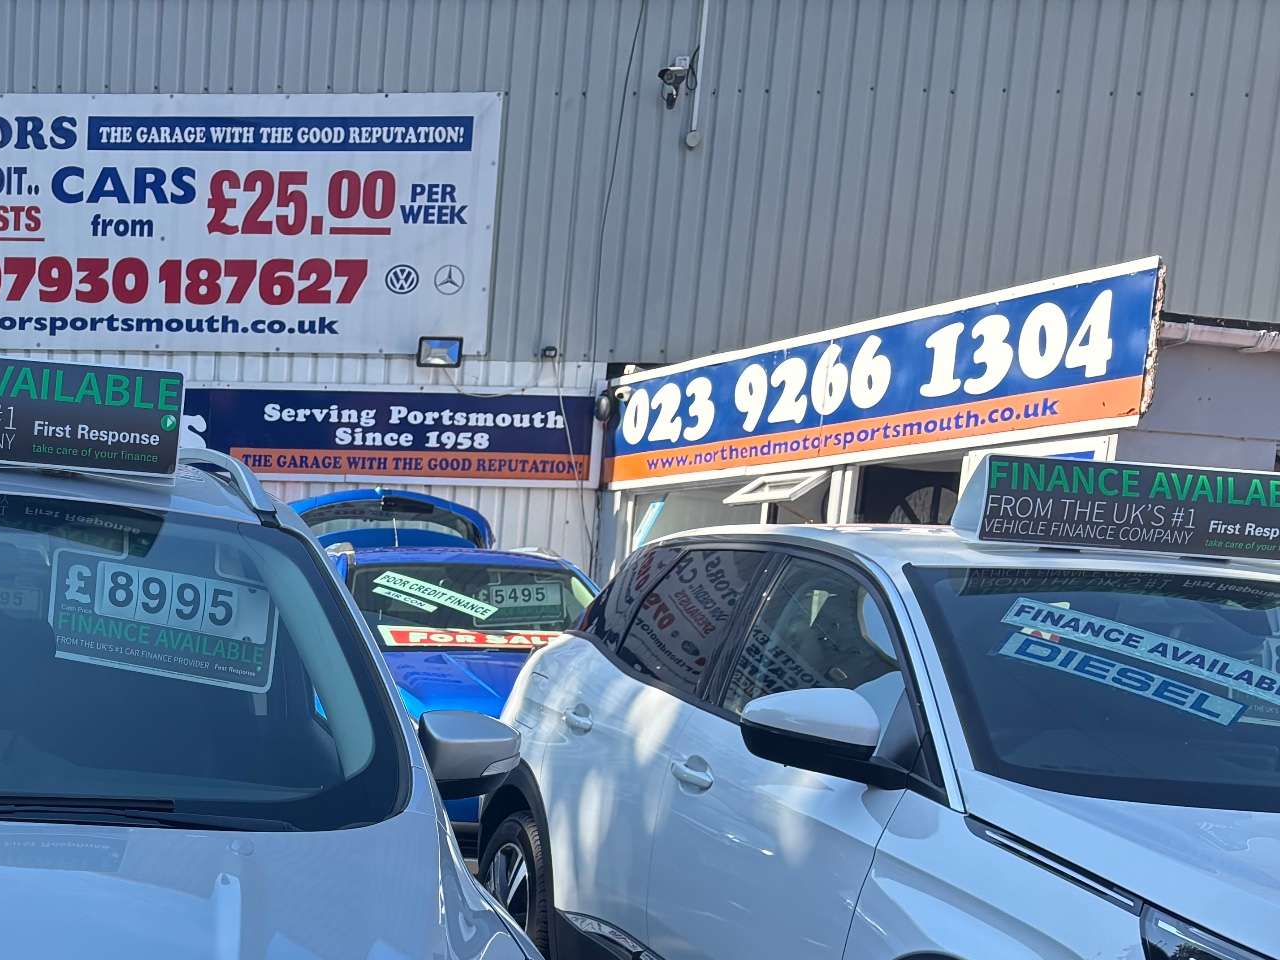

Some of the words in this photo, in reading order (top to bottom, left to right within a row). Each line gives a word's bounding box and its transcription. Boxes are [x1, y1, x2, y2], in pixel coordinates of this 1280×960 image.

[99, 126, 132, 143] THE
[136, 126, 206, 143] GARAGE
[209, 126, 255, 143] WITH
[260, 127, 293, 143] THE
[297, 127, 345, 143] GOOD
[348, 127, 464, 143] REPUTATION!
[51, 167, 197, 204] CARS
[410, 184, 456, 203] PER
[207, 170, 396, 235] £25.00
[401, 205, 467, 225] WEEK
[91, 214, 154, 238] from
[159, 258, 368, 305] 187627
[622, 375, 716, 446] 023
[734, 335, 892, 434] 9266
[920, 289, 1114, 398] 1304
[263, 403, 376, 427] Serving
[389, 406, 565, 430] Portsmouth
[34, 420, 71, 439] First
[77, 424, 160, 446] Response
[335, 428, 415, 448] Since
[425, 431, 490, 450] 1958
[646, 397, 1060, 471] www.northendmotorsportsmouth.co.uk
[32, 443, 54, 454] take
[56, 446, 78, 456] care
[81, 447, 92, 457] of
[95, 450, 118, 460] your
[121, 450, 158, 463] finance
[242, 454, 272, 468] THE
[277, 455, 342, 469] GARAGE
[347, 456, 388, 470] WITH
[393, 457, 423, 470] THE
[428, 458, 472, 471] GOOD
[476, 459, 583, 474] REPUTATION!
[989, 461, 1140, 497] FINANCE
[986, 495, 1053, 519] FROM
[1061, 499, 1106, 522] THE
[1113, 503, 1165, 526] UK'S
[1171, 506, 1196, 529] #1
[984, 518, 1046, 536] VEHICLE
[1050, 522, 1114, 540] FINANCE
[1119, 526, 1193, 545] COMPANY
[1209, 520, 1241, 535] First
[66, 565, 91, 603] £
[108, 570, 234, 627] 8995
[379, 575, 407, 588] POOR
[409, 583, 447, 600] CREDIT
[448, 595, 491, 617] FINANCE
[495, 587, 546, 604] 5495
[56, 635, 78, 647] FROM
[79, 638, 95, 649] THE
[125, 647, 141, 657] CAR
[141, 649, 173, 664] FINANCE
[174, 655, 210, 669] PROVIDER
[58, 612, 150, 645] FINANCE
[156, 630, 265, 664] AVAILABLE
[408, 631, 477, 644] FOR
[484, 634, 552, 645] SAL
[1014, 604, 1144, 650] FINANCE
[1149, 641, 1280, 696] AVAILAB
[1015, 637, 1223, 719] DIESEL
